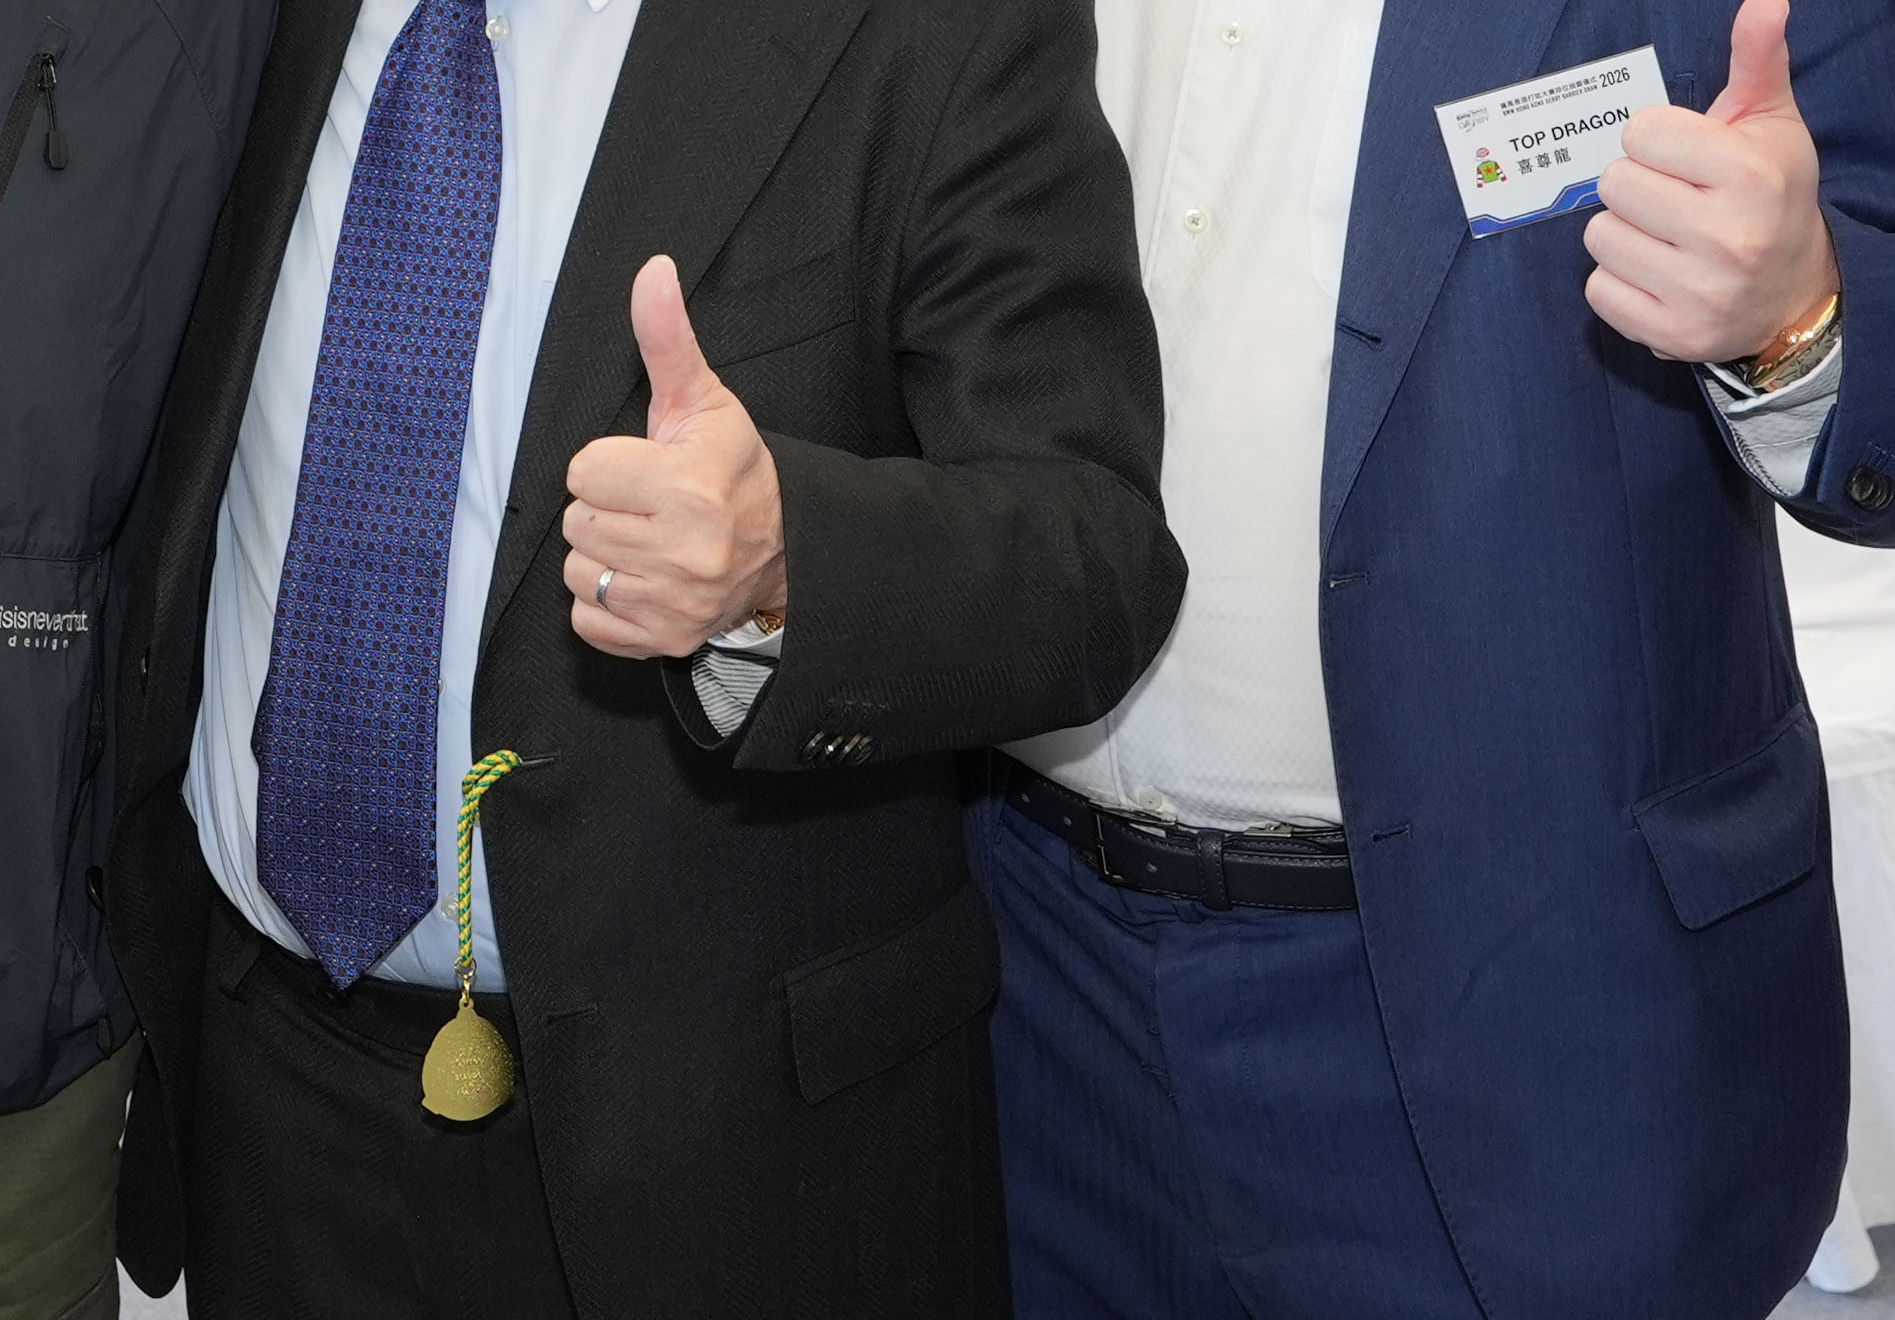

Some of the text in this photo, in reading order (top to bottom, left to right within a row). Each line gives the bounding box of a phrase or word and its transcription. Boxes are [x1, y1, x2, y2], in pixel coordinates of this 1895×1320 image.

[1599, 67, 1630, 88] 2026
[1509, 106, 1630, 152] TOP DRAGON
[8, 635, 69, 651] design
